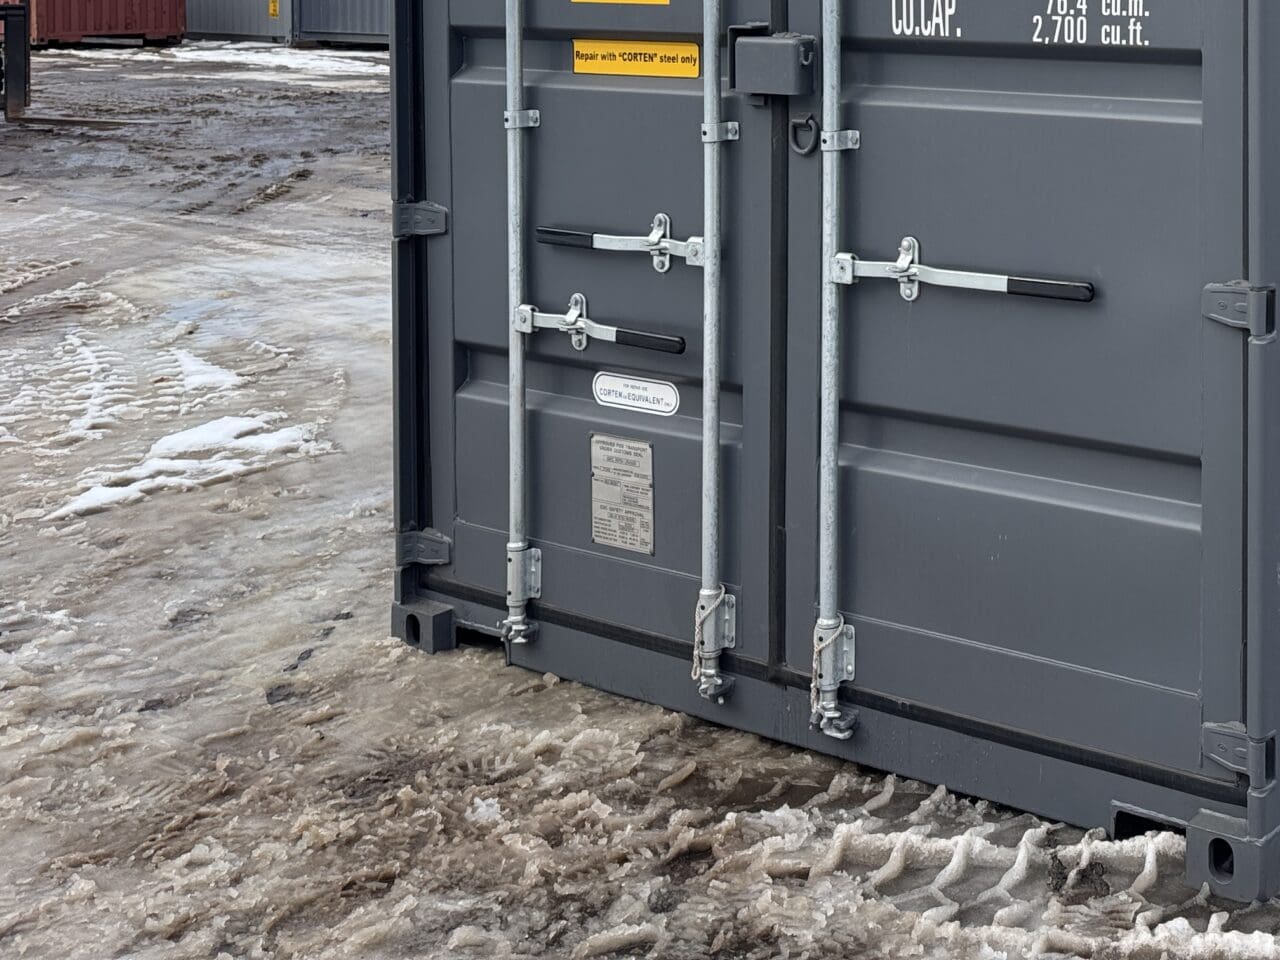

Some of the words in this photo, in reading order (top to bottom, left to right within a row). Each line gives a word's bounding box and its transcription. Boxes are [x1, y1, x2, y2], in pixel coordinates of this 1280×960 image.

[1032, 15, 1087, 44] 2,700
[1101, 18, 1150, 46] cu.ft.
[575, 50, 599, 62] Repair
[600, 52, 617, 61] with
[659, 53, 679, 64] steel
[681, 54, 697, 66] only
